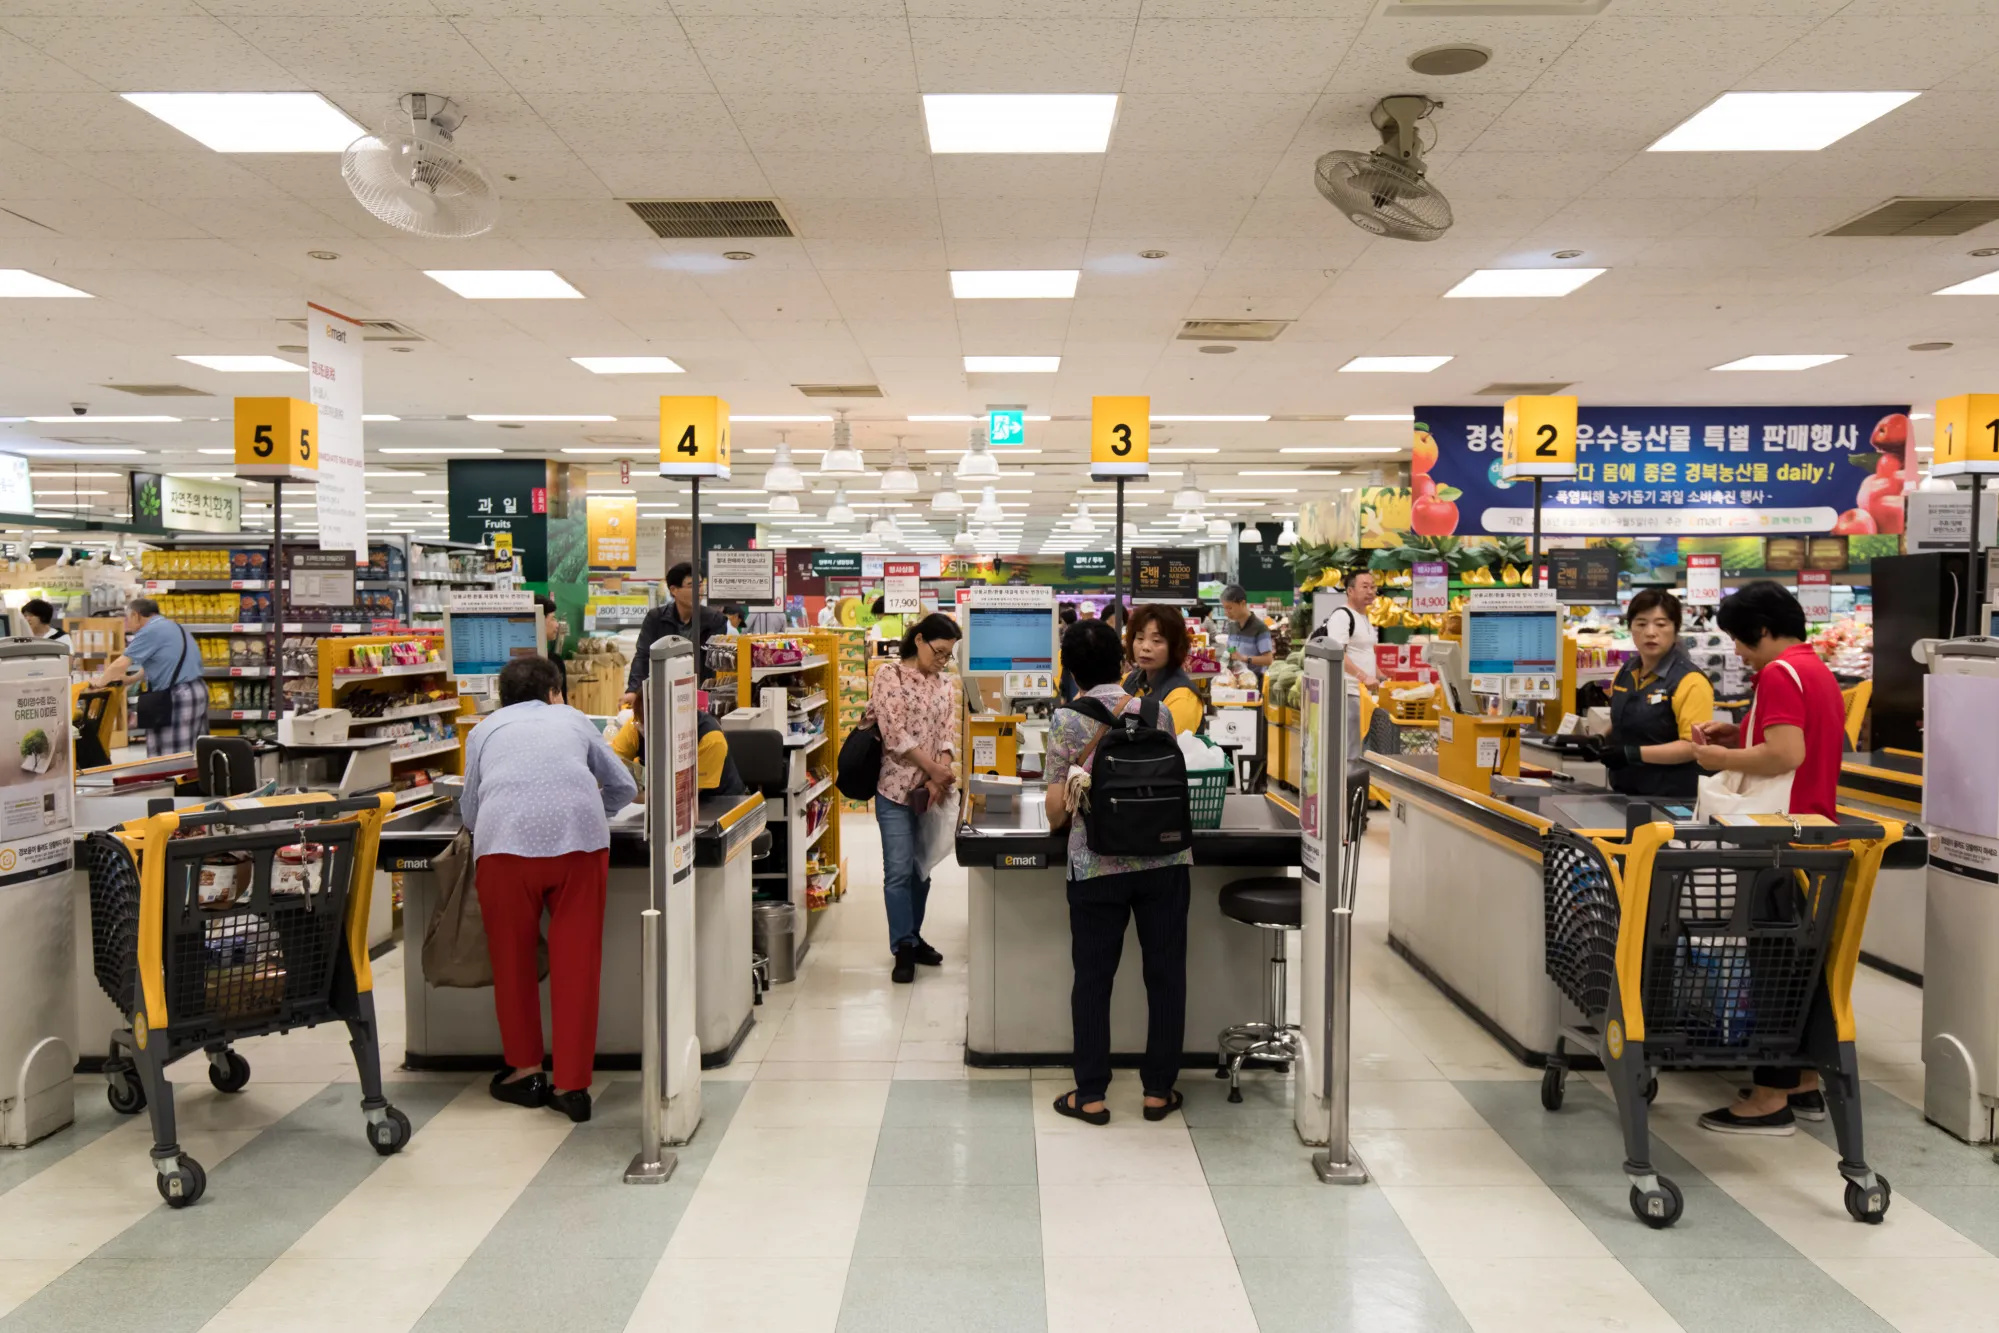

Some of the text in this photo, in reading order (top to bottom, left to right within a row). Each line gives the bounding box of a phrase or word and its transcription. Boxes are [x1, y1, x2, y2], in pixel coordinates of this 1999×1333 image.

[326, 324, 347, 344] emart
[253, 425, 274, 457] 5
[677, 424, 698, 456] 4
[720, 428, 726, 459] 4
[1111, 424, 1132, 456] 3
[1507, 428, 1514, 459] 2
[1536, 424, 1558, 456] 2
[1577, 424, 1691, 453] 우수농산물
[1703, 424, 1749, 452] 특별
[1763, 424, 1859, 453] 판매행사
[1945, 422, 1954, 455] 1
[1985, 418, 1999, 452] 1
[300, 429, 311, 460] 5
[1603, 462, 1635, 483] 몸에
[1644, 463, 1677, 483] 좋은
[1685, 463, 1768, 483] 경북농산물
[171, 491, 233, 521] 자연주의 친환경
[1608, 490, 1656, 505] 농가돕기
[1659, 489, 1684, 505] 과일
[1687, 489, 1736, 504] 소비촉진
[1740, 489, 1765, 504] 행사
[485, 519, 512, 529] Fruits
[496, 561, 512, 570] Pick
[1140, 566, 1160, 579] 2배
[1415, 597, 1446, 607] 14,900
[1690, 588, 1718, 599] 12,900
[621, 606, 648, 615] 32,900
[889, 598, 918, 609] 17,900
[1803, 605, 1828, 617] 2,900
[17, 696, 57, 708] 종이영수증 없는
[15, 706, 58, 721] GREEN 이마트
[396, 858, 428, 869] emart
[1004, 855, 1037, 866] emart
